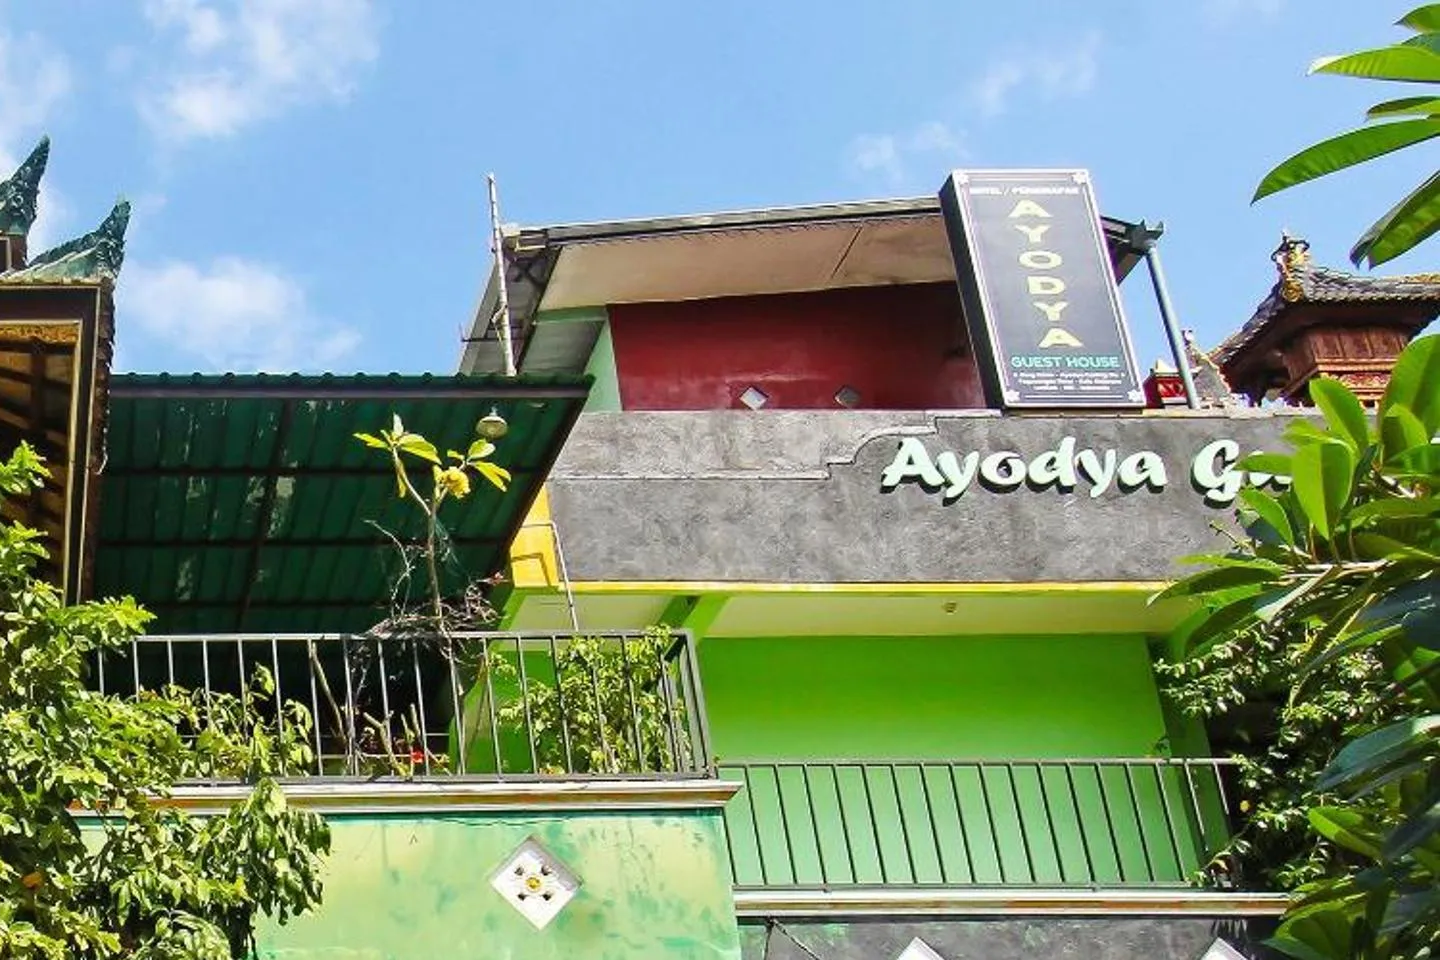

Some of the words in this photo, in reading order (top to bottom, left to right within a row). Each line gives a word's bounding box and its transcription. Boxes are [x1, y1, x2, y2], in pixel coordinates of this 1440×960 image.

[1008, 199, 1084, 348] AYODYA
[1011, 356, 1062, 368] GUEST
[1065, 356, 1120, 368] HOUSE
[881, 436, 1167, 498] Ayodya
